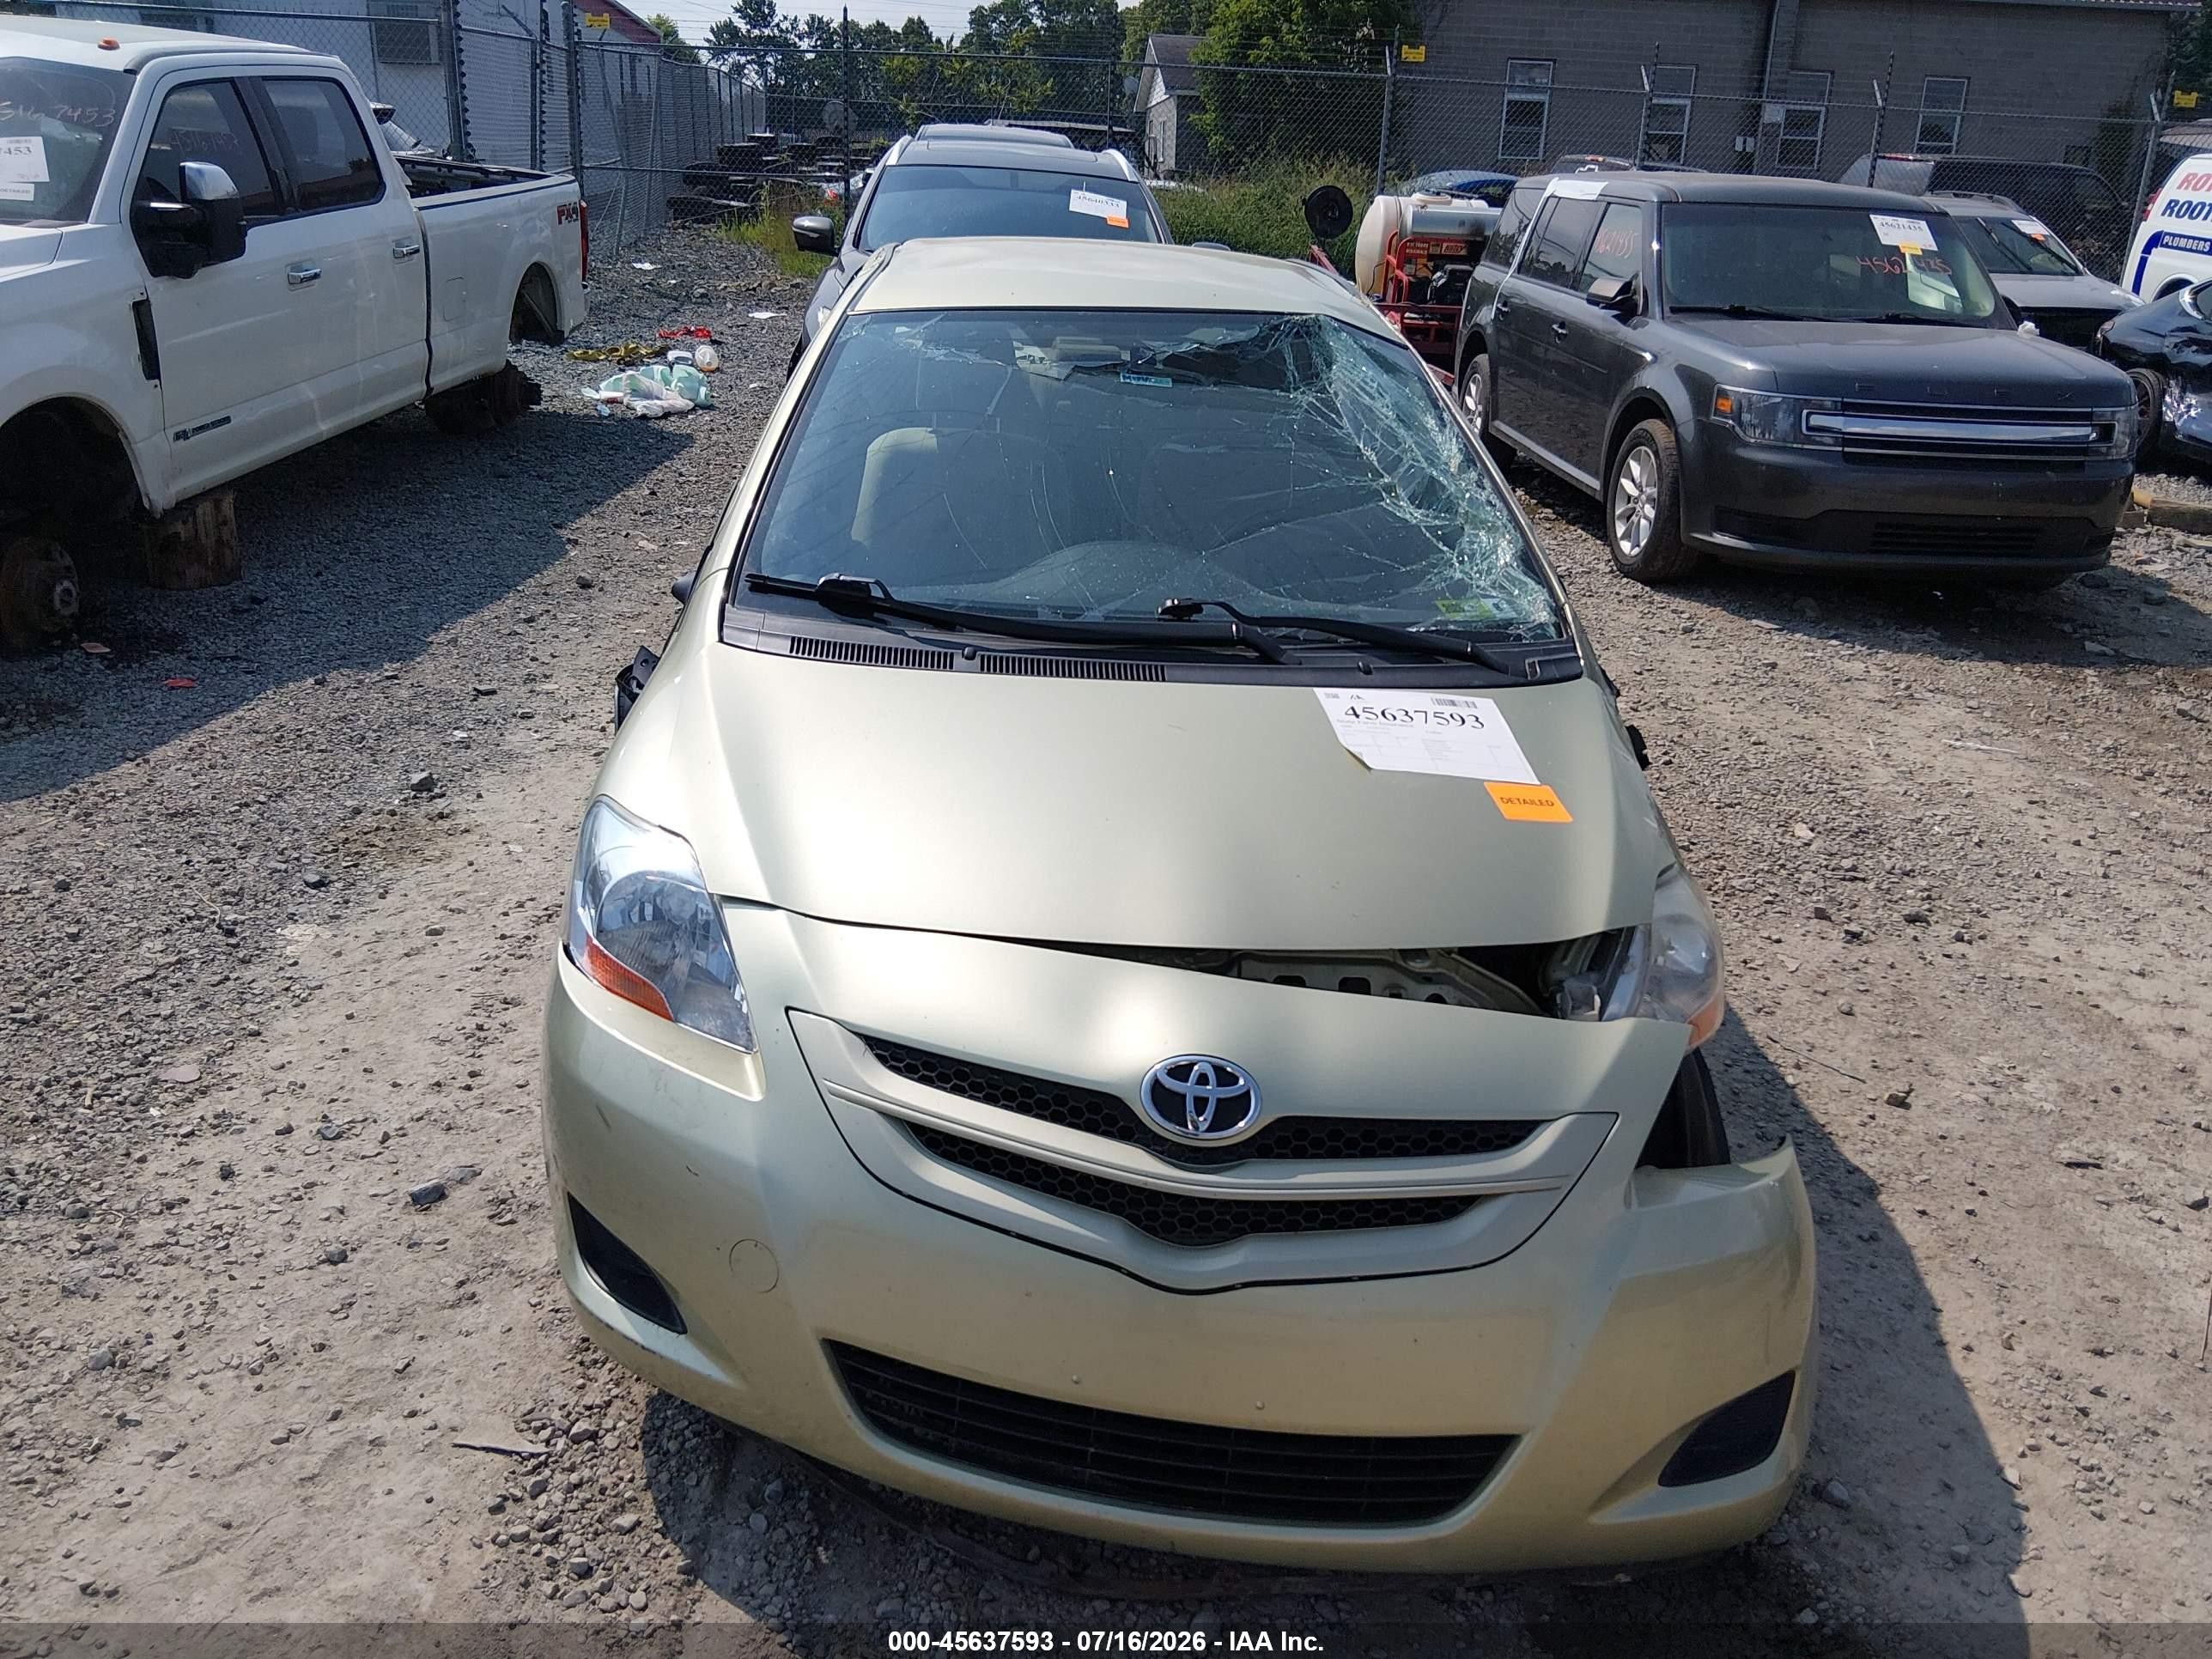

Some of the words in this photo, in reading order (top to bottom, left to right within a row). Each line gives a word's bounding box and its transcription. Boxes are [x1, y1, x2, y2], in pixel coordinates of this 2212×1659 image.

[2162, 234, 2211, 252] PLUMBERS
[1345, 705, 1485, 728] 45637593
[1499, 796, 1555, 808] DETAILED
